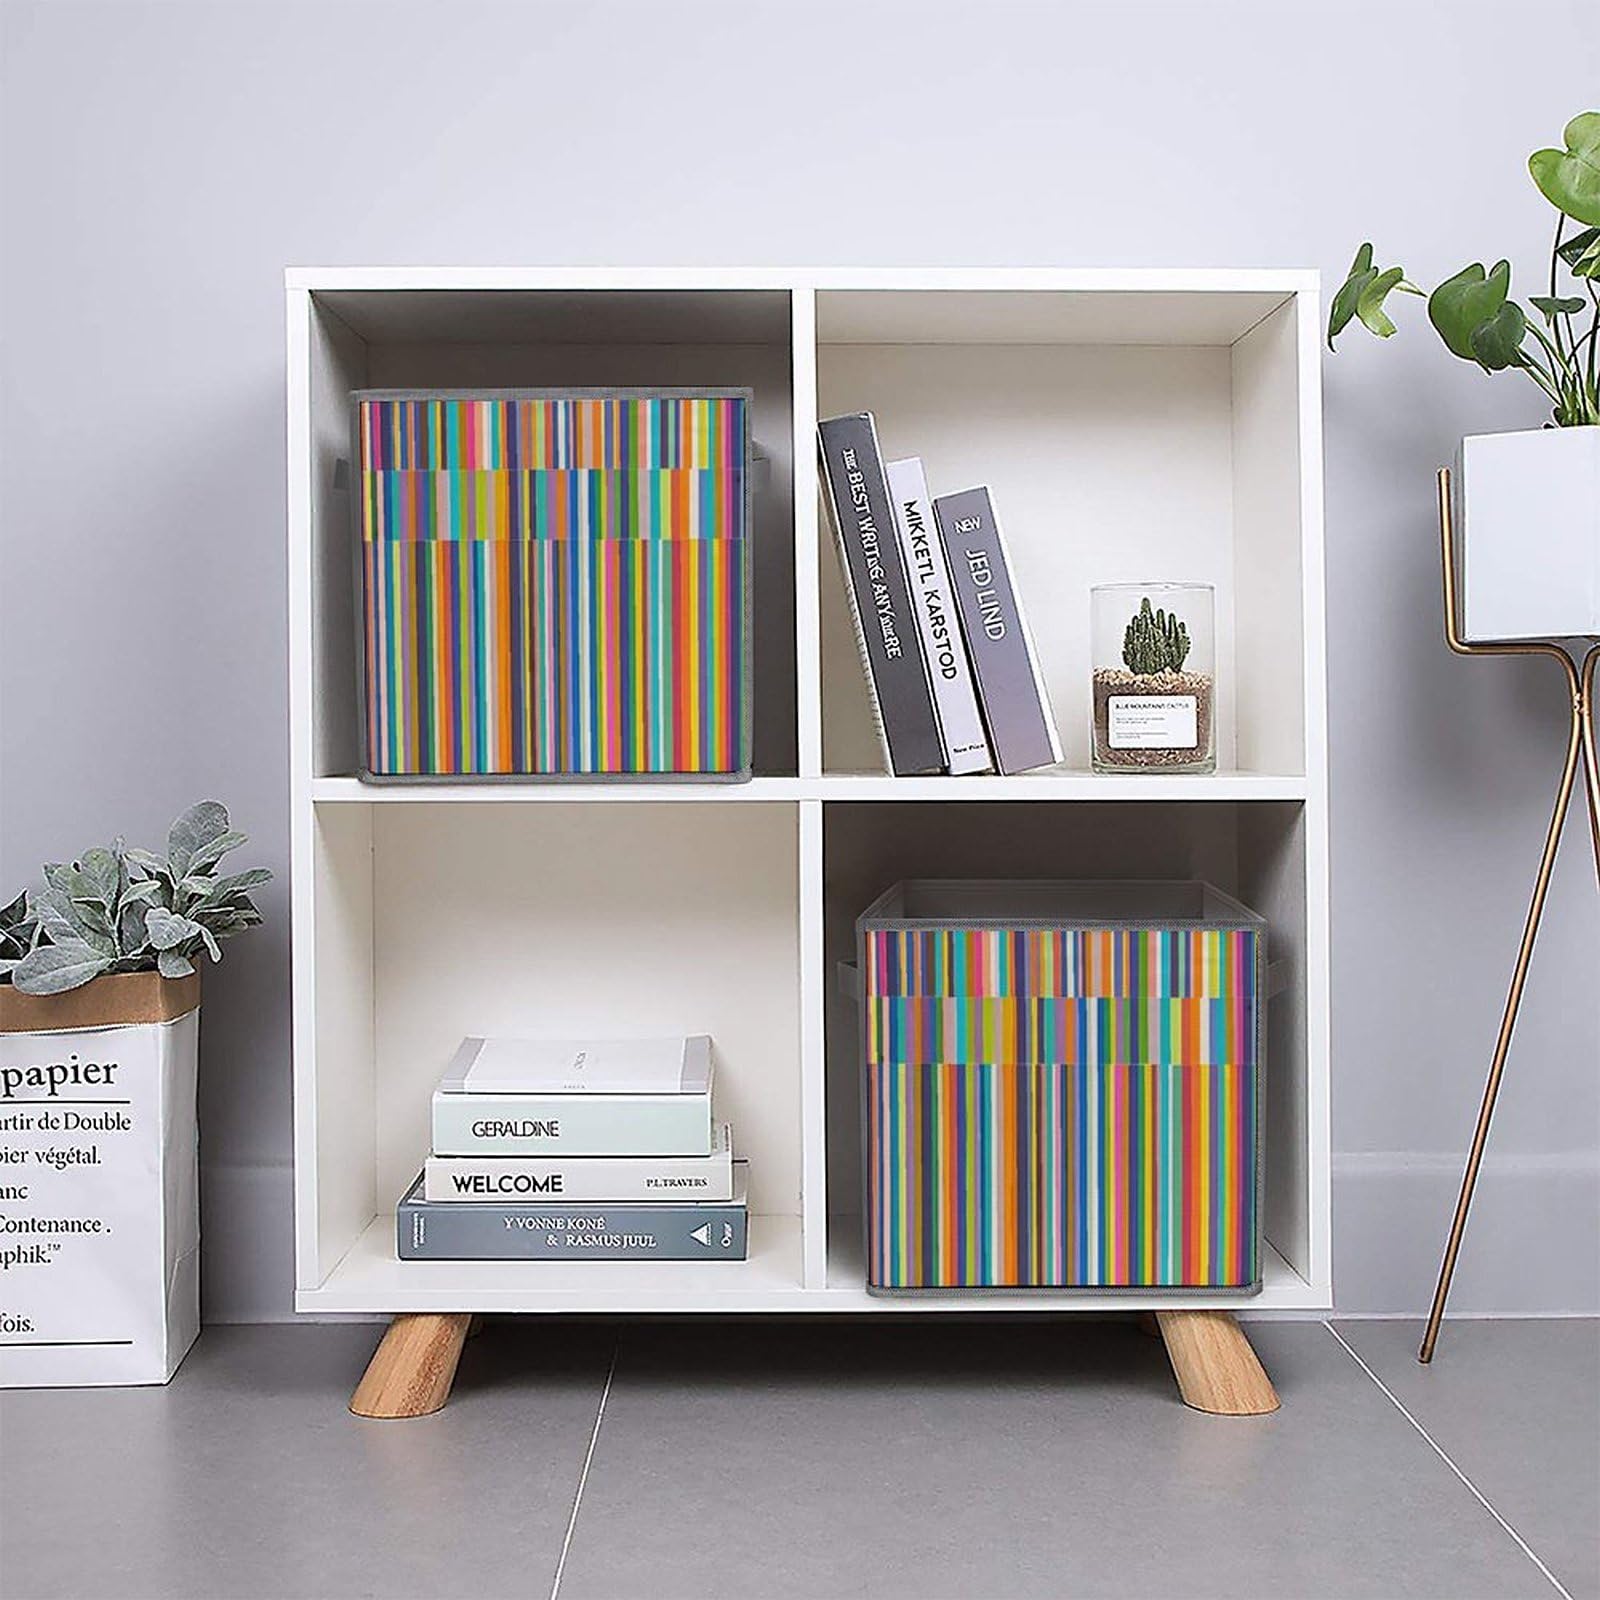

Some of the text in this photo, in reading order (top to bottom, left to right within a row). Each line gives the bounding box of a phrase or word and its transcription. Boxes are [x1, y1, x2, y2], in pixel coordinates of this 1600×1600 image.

[847, 471, 871, 514] BEST
[955, 516, 981, 533] NEW
[903, 500, 958, 680] MIKKETL KARSTOD
[966, 549, 1006, 641] JED LIND
[0, 1055, 118, 1098] papier
[37, 1111, 60, 1131] de
[63, 1111, 131, 1131] Double
[472, 1120, 560, 1137] GERALDINE
[34, 1145, 102, 1171] végétal.
[452, 1174, 563, 1193] WELCOME
[546, 1233, 657, 1249] & RASMUS JUUL
